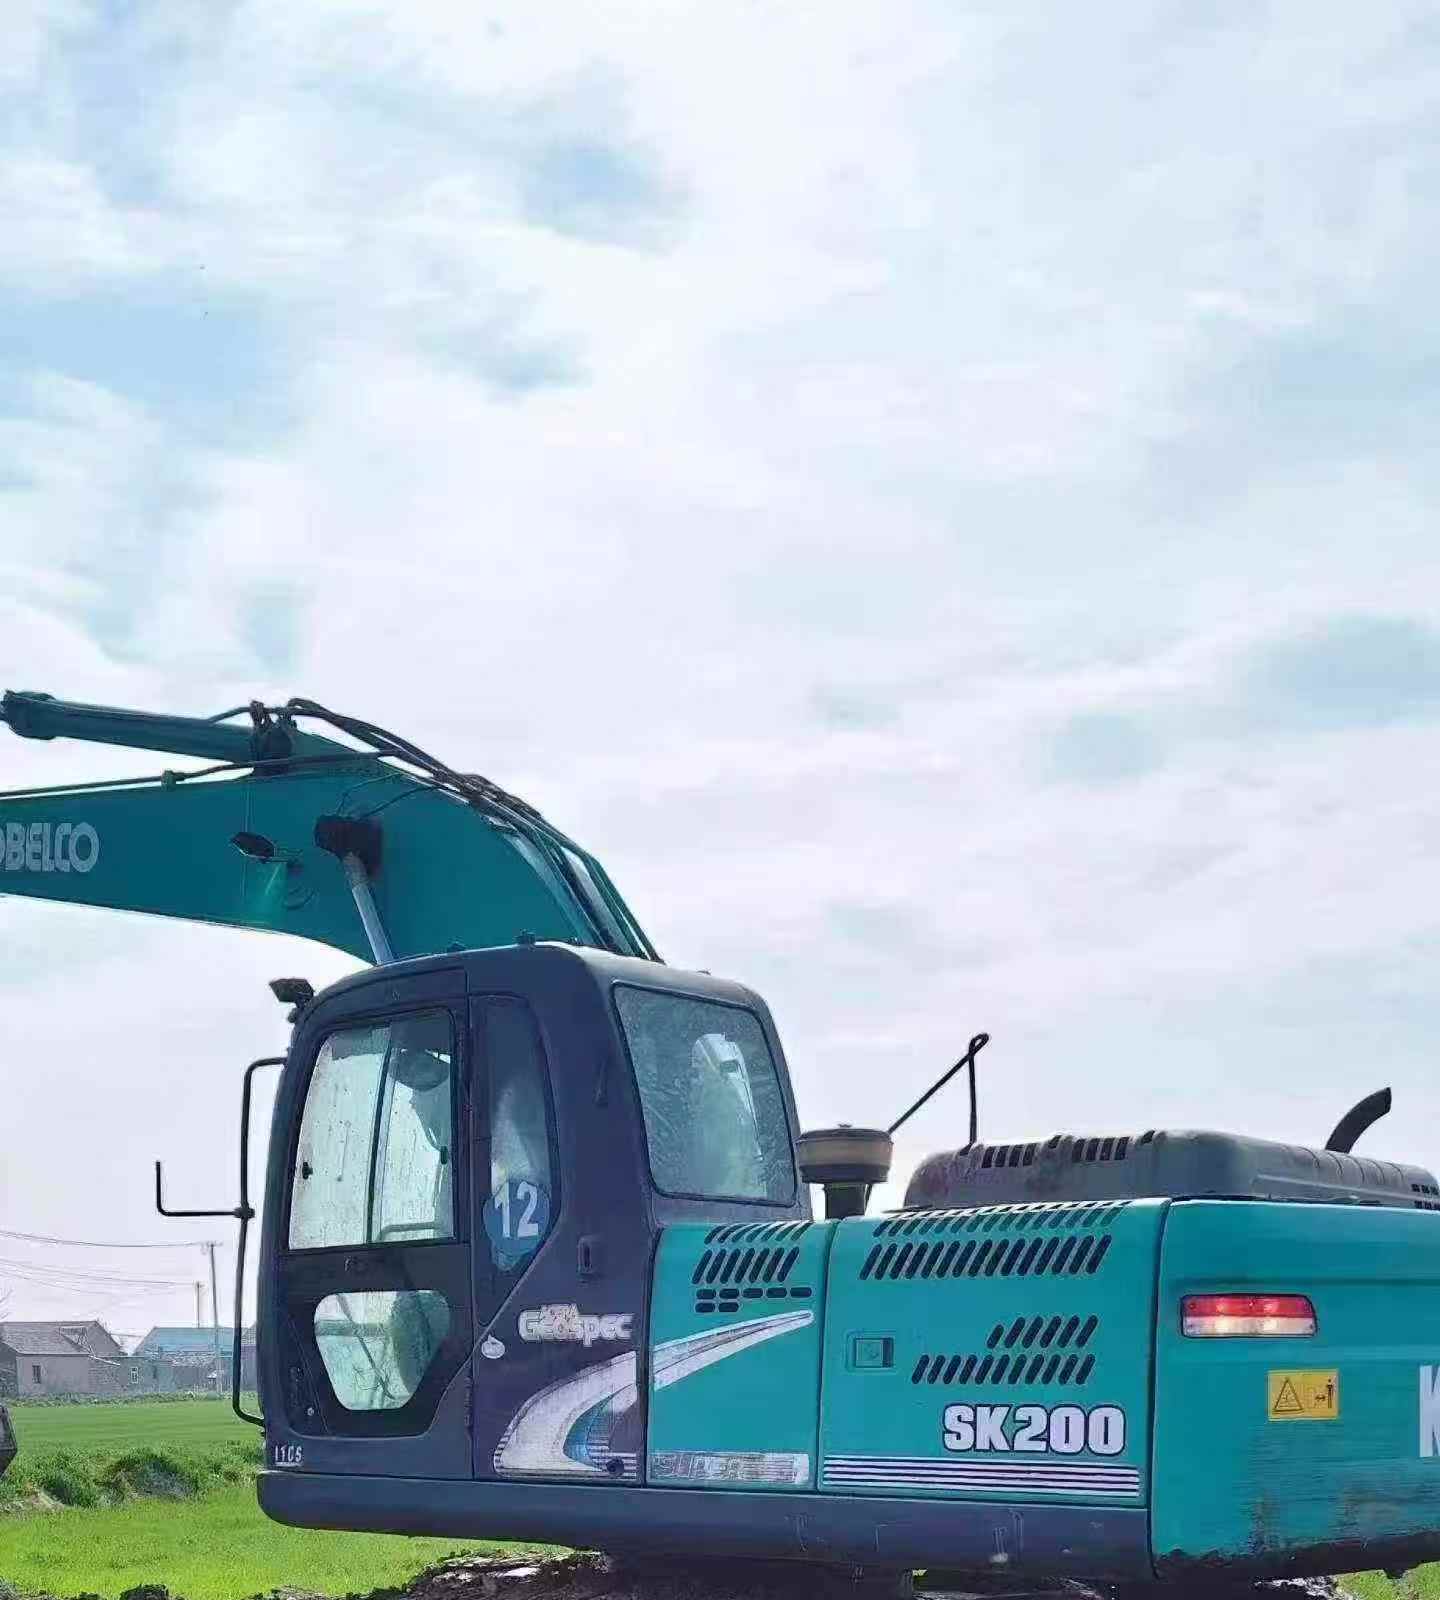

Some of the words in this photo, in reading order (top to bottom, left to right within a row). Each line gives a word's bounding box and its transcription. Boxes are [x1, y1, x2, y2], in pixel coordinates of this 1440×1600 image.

[0, 822, 100, 872] BELCO
[494, 1181, 539, 1237] 12
[942, 1403, 1126, 1457] SK200
